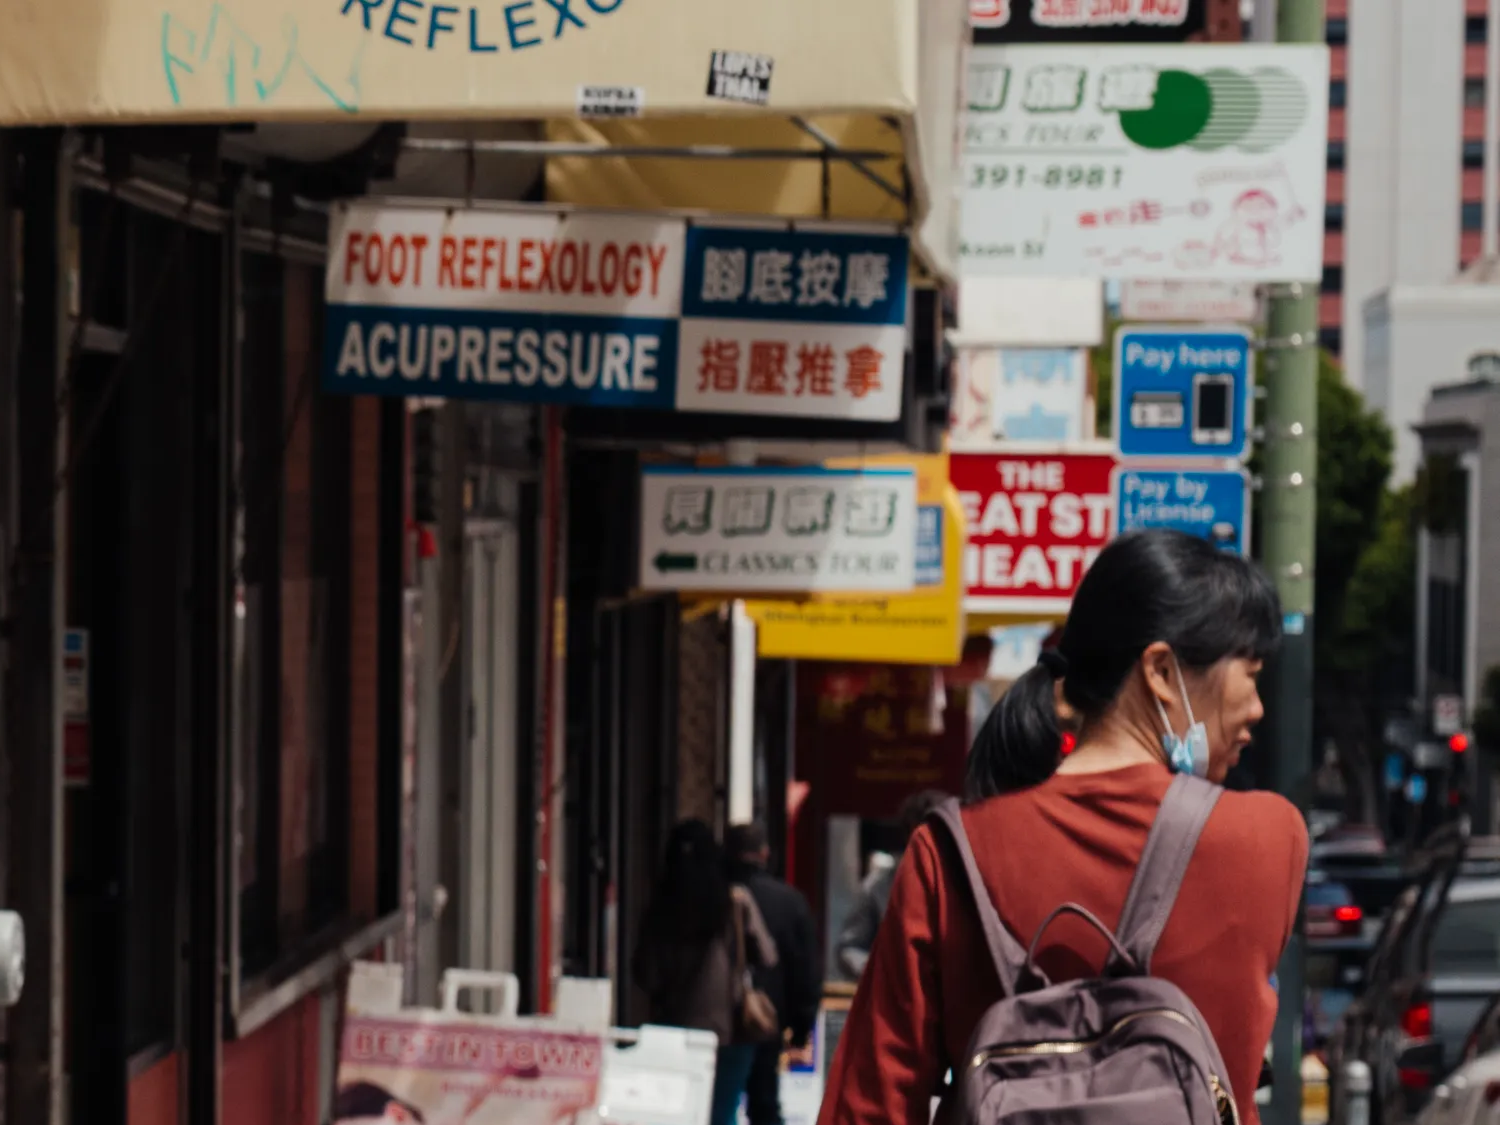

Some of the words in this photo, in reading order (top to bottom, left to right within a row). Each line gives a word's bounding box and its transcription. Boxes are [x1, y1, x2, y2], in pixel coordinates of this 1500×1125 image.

[344, 231, 428, 286] FOOT
[438, 236, 668, 298] REFLEXOLOGY
[336, 321, 660, 390] ACUPRESSURE
[698, 337, 885, 398] 指壓推拿
[1126, 342, 1173, 374] Pay
[1179, 341, 1241, 369] here
[997, 460, 1064, 491] THE
[1124, 474, 1170, 501] Pay
[1176, 472, 1208, 500] by
[1124, 501, 1215, 525] License
[704, 553, 819, 574] CLASSICS
[828, 553, 899, 574] TOUR
